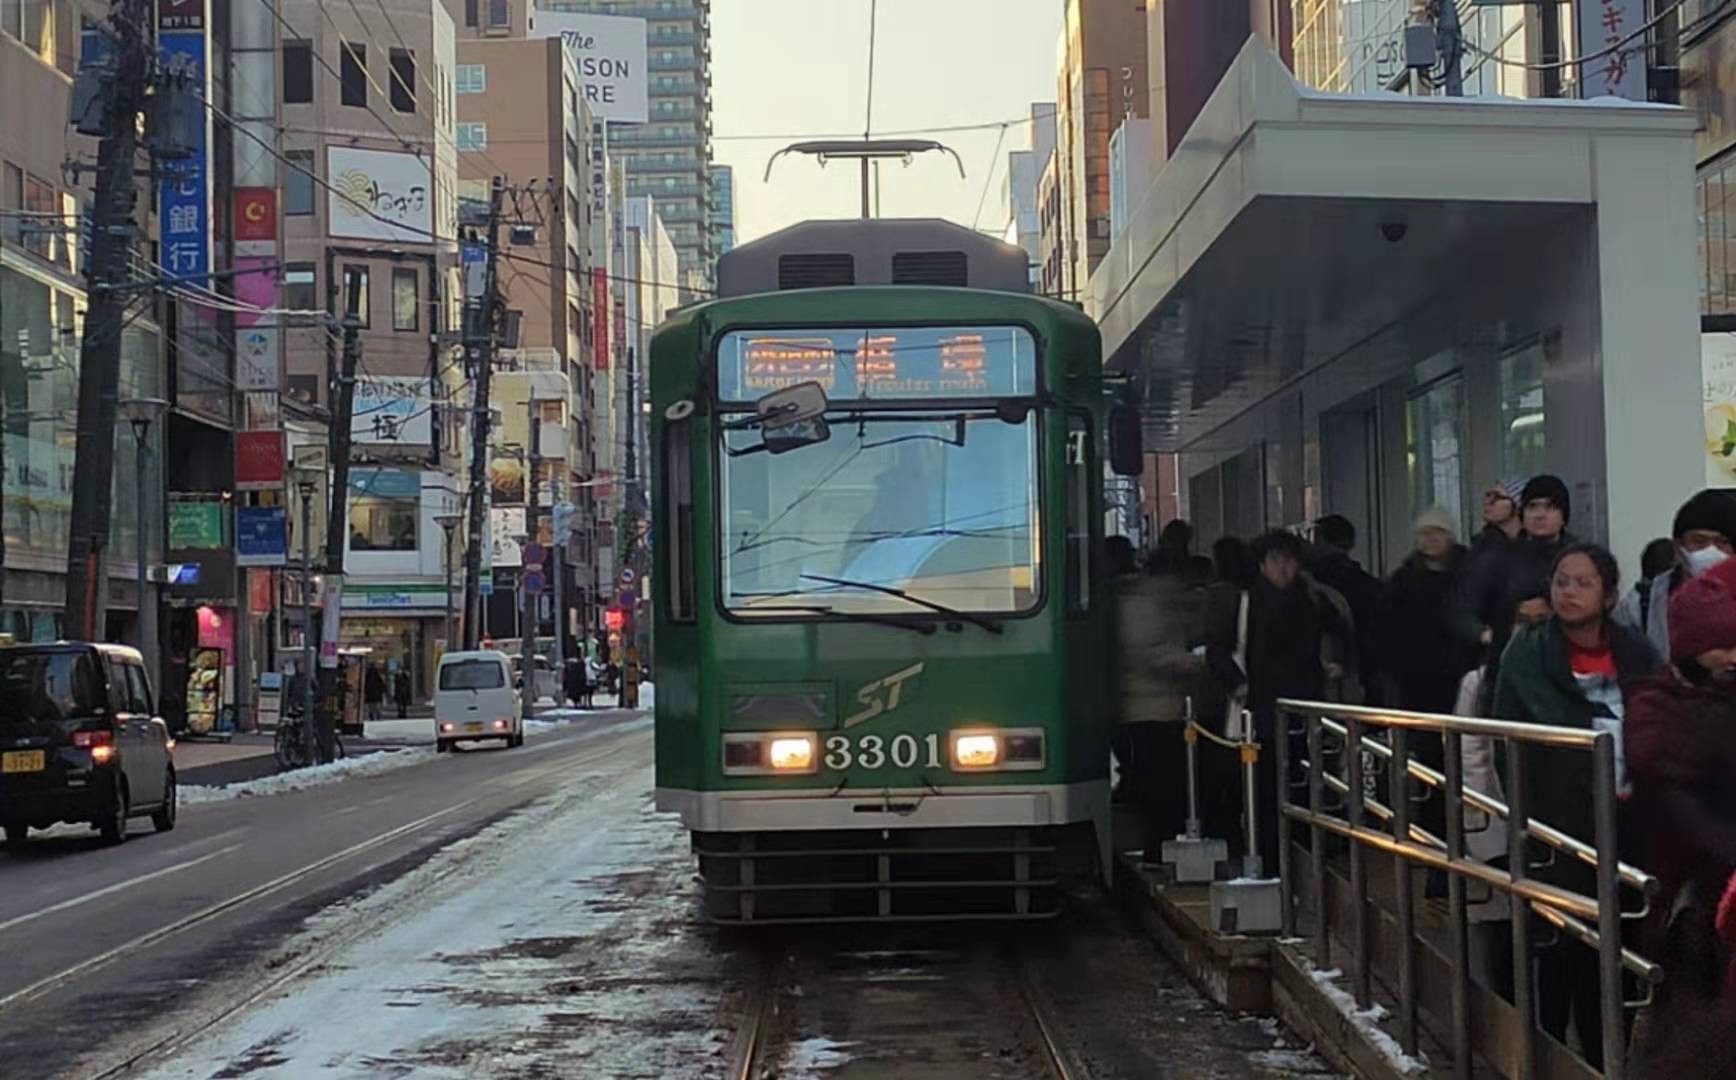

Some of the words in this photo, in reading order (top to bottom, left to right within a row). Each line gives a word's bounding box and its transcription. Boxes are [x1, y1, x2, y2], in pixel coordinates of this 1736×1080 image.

[561, 30, 594, 49] The
[580, 84, 615, 103] RE
[824, 734, 942, 770] 3301
